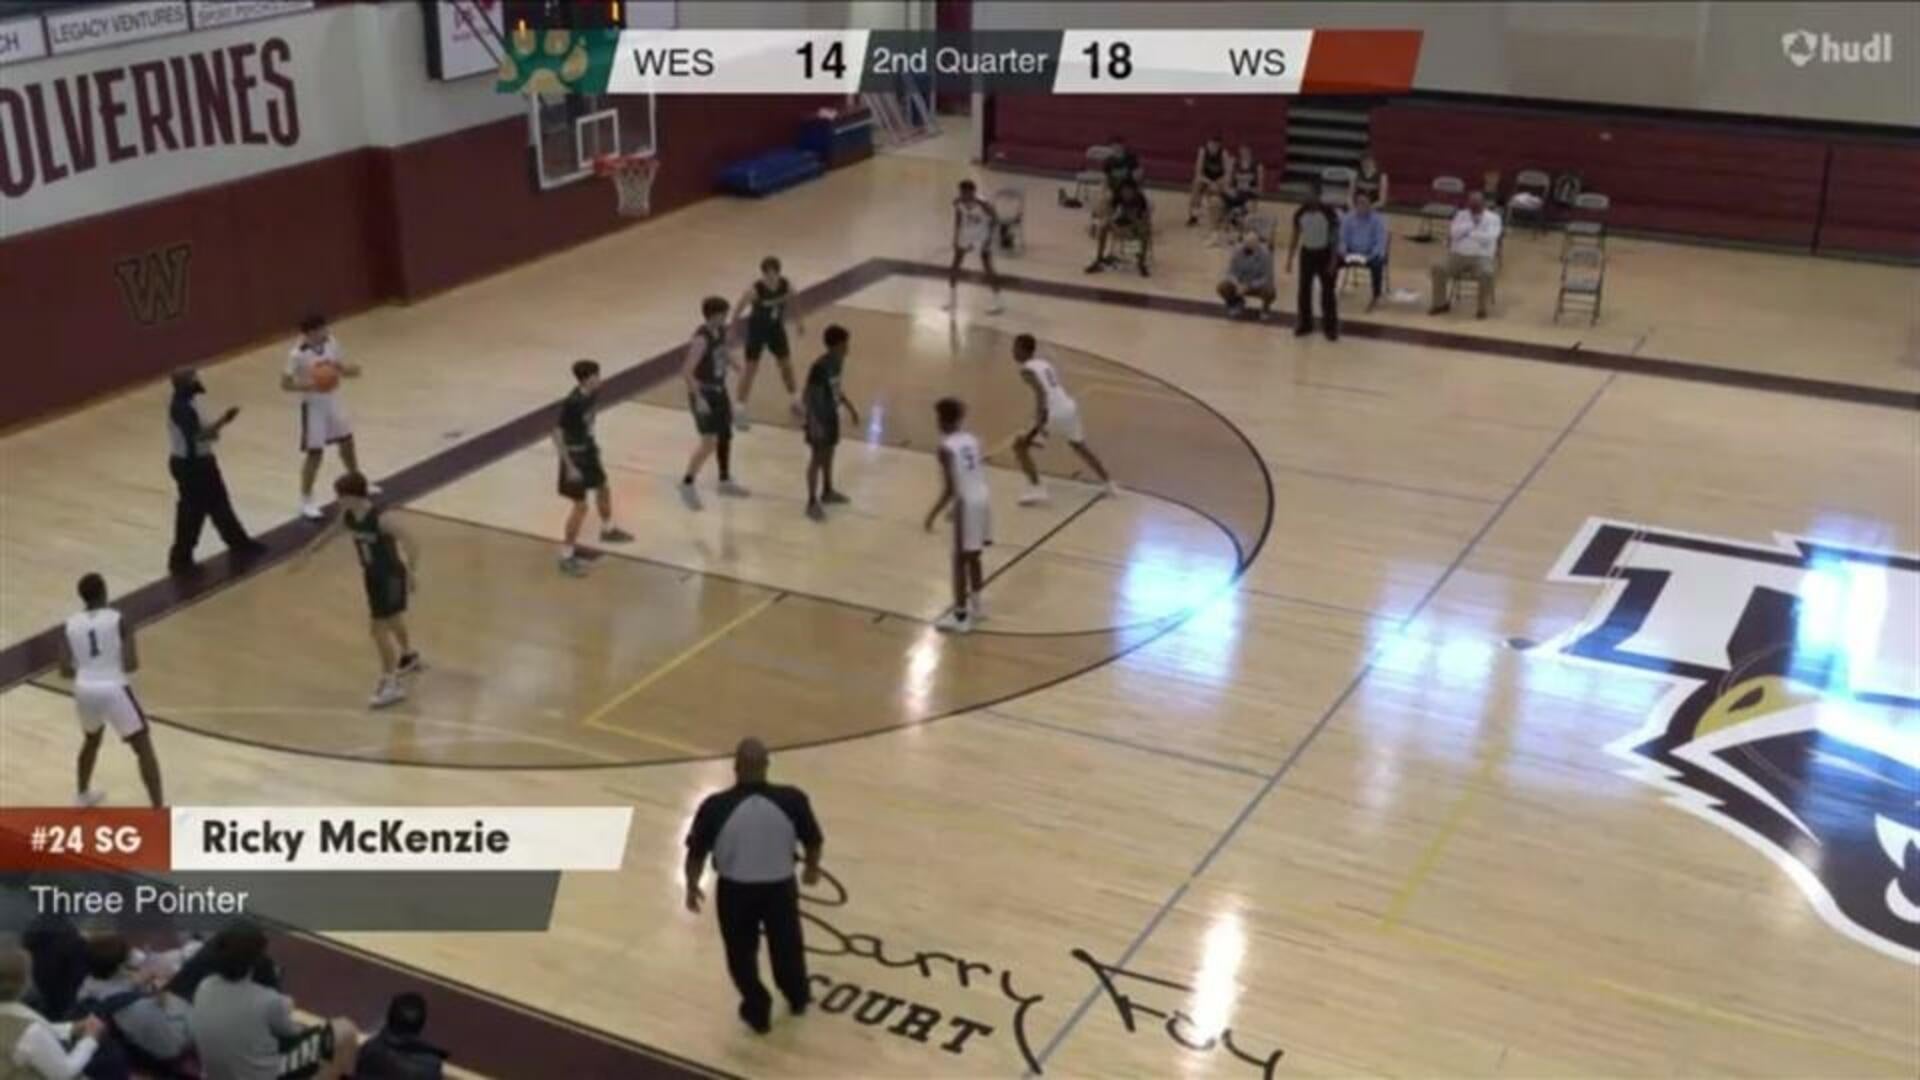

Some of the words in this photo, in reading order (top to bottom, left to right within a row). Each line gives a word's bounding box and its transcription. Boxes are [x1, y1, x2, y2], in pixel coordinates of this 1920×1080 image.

[54, 18, 109, 44] LEGACY
[111, 6, 184, 32] VENTURES
[114, 243, 192, 325] W
[88, 629, 101, 657] 1
